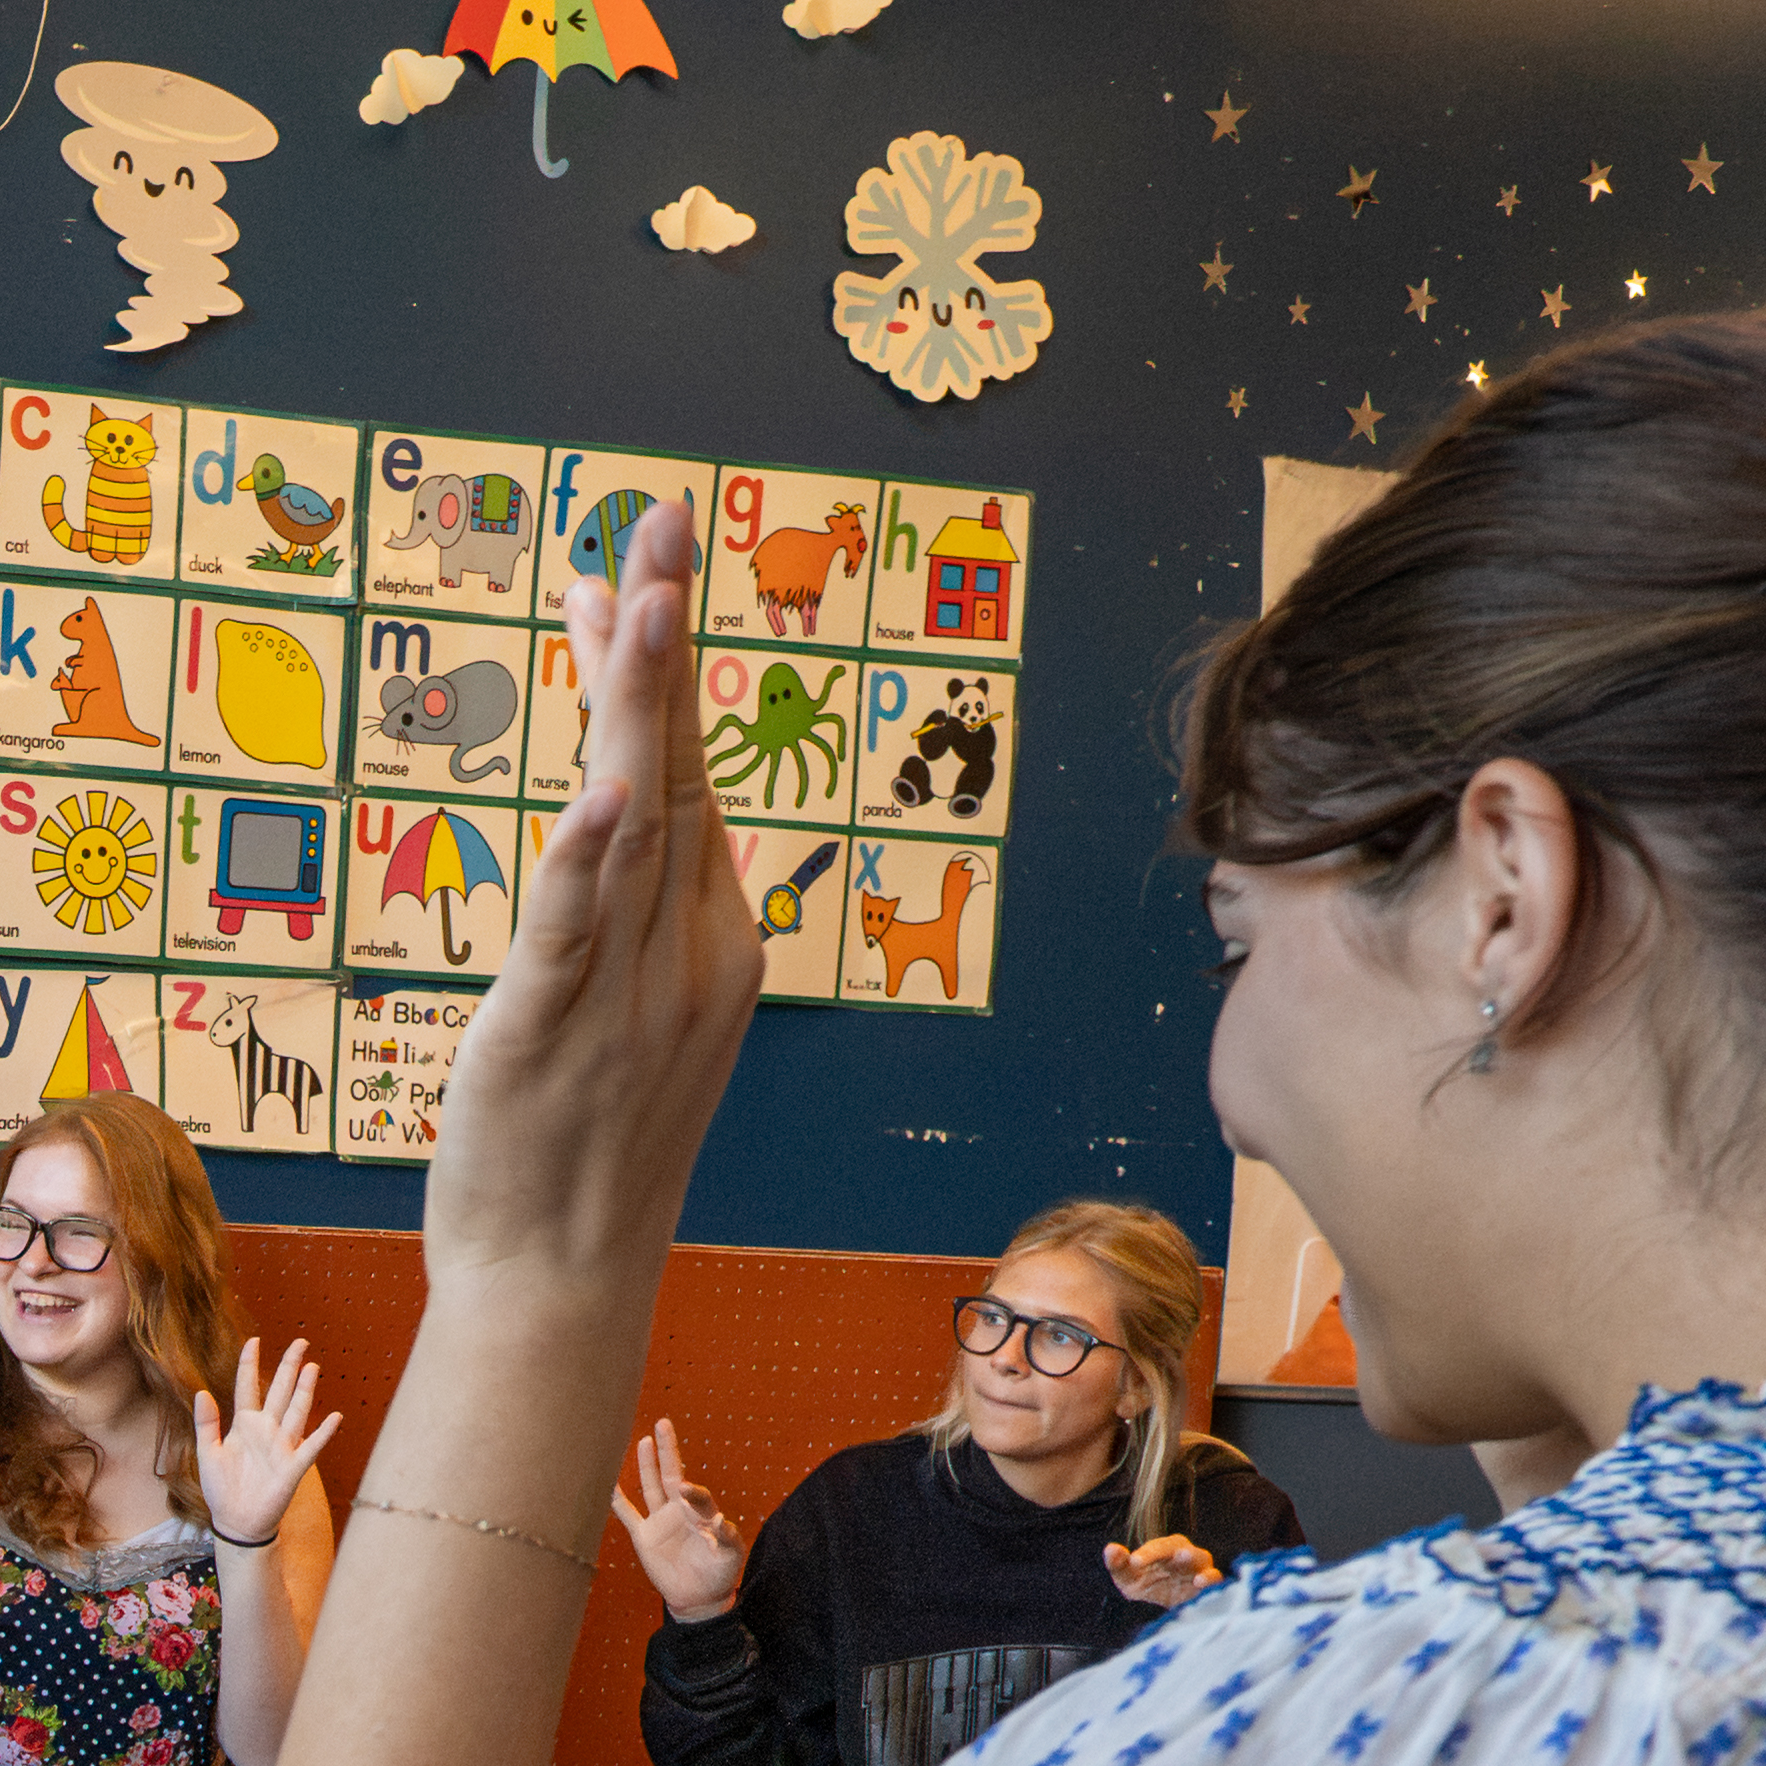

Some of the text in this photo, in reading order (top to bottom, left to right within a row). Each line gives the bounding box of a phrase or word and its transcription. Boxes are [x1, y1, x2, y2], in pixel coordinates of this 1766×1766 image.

[10, 395, 51, 451] c
[192, 418, 237, 506] d
[381, 437, 423, 493] e
[551, 453, 584, 537] f
[724, 475, 764, 553] g
[5, 539, 29, 555] cat
[883, 488, 918, 573] h
[188, 554, 223, 575] duck
[373, 575, 435, 599] elephant
[0, 588, 37, 679] k
[713, 613, 744, 631] goat
[875, 622, 915, 642] house
[186, 606, 203, 694] l
[370, 620, 431, 676] m
[541, 637, 578, 690] n
[707, 655, 750, 707] o
[868, 669, 908, 753] p
[178, 743, 221, 764] lemon
[362, 761, 410, 777] mouse
[531, 777, 570, 792] nurse
[177, 794, 202, 865] t
[356, 802, 394, 855] u
[862, 801, 903, 822] panda
[853, 842, 885, 891] x
[173, 933, 237, 953] television
[351, 939, 408, 959] umbrella
[173, 981, 208, 1032] z
[353, 999, 381, 1023] Aa
[393, 1001, 423, 1025] Bb
[352, 1039, 379, 1063] Hh
[403, 1042, 416, 1064] Ii
[350, 1078, 436, 1112] Oo Pp
[182, 1118, 211, 1134] ebra
[349, 1118, 425, 1145] Uu Vv
